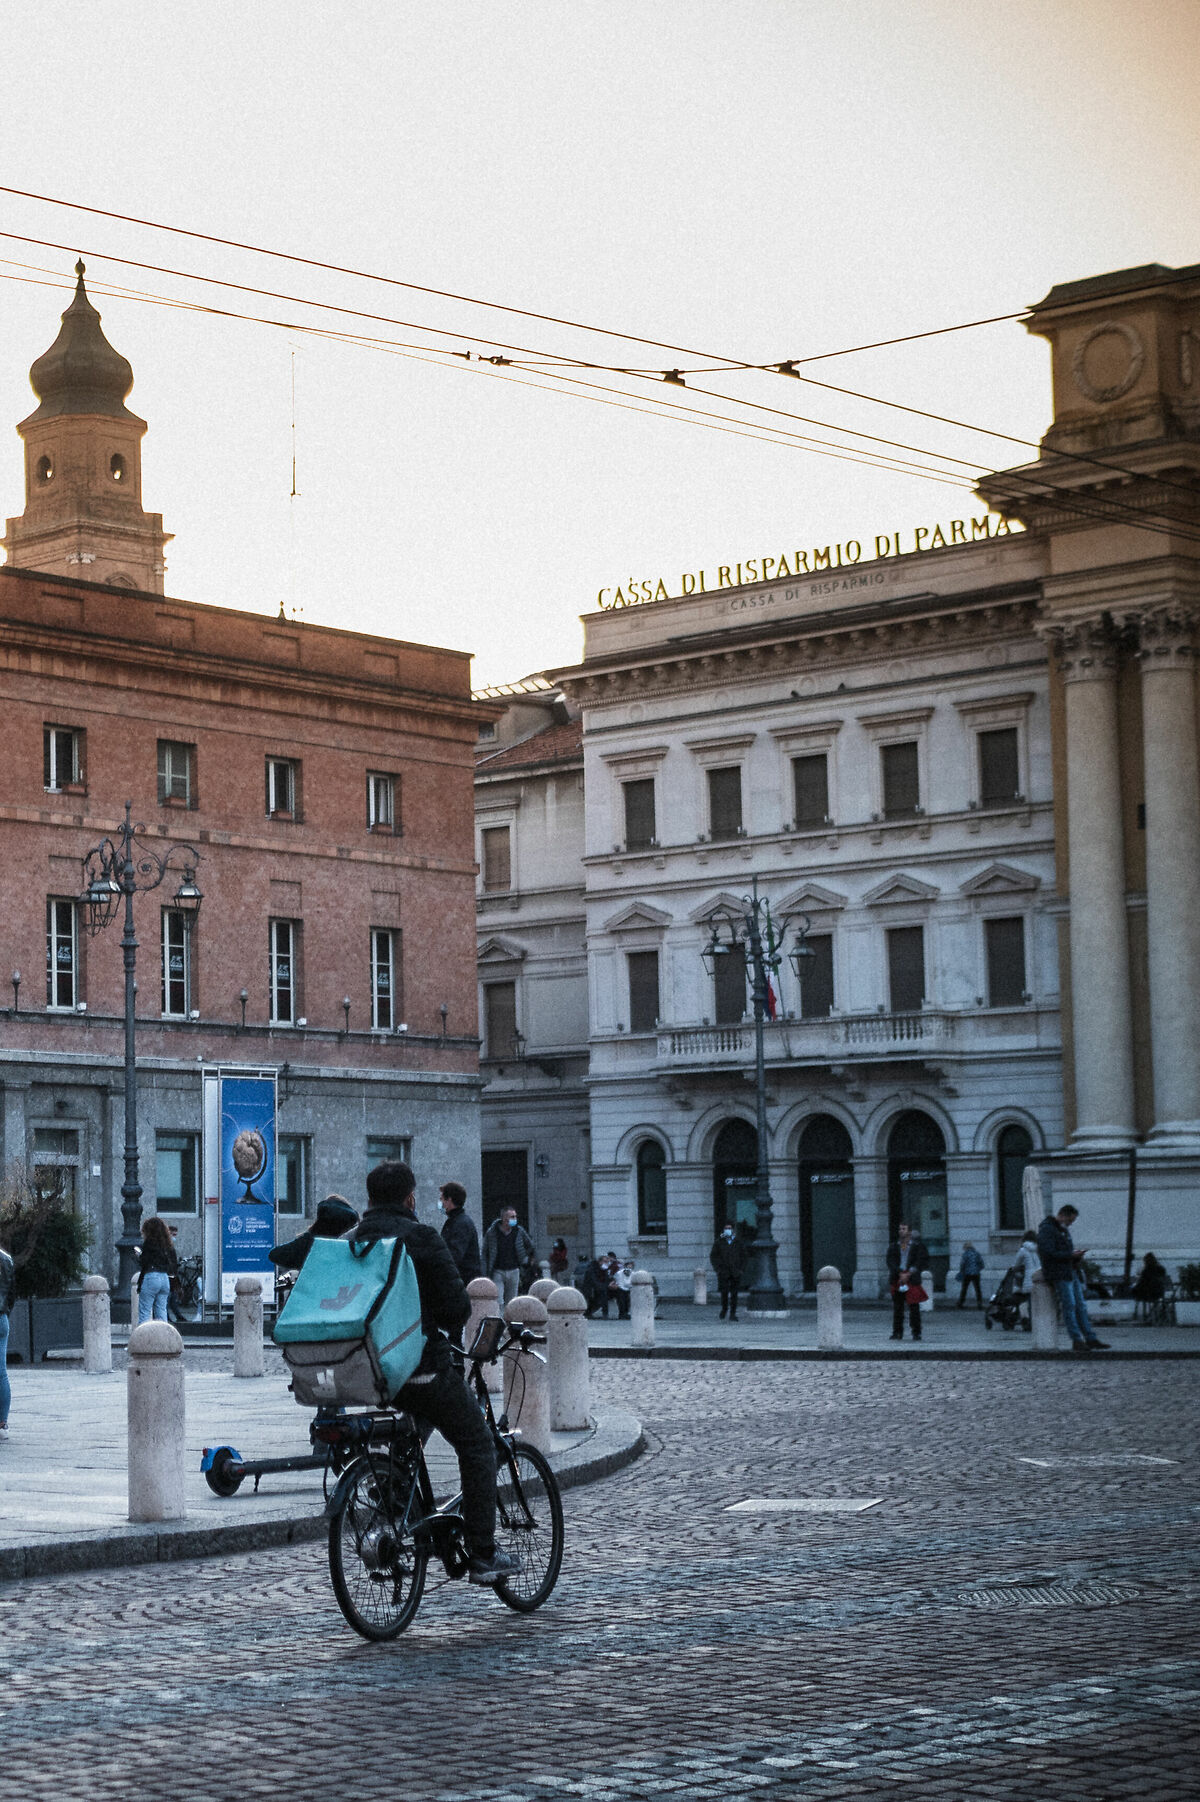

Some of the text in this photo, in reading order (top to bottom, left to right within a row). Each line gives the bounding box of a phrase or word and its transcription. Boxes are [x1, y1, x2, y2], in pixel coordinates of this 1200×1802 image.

[597, 513, 1013, 611] CASSA DI RISPARMIO DI PARMA
[730, 572, 885, 611] CASSA DI RISPARMIO
